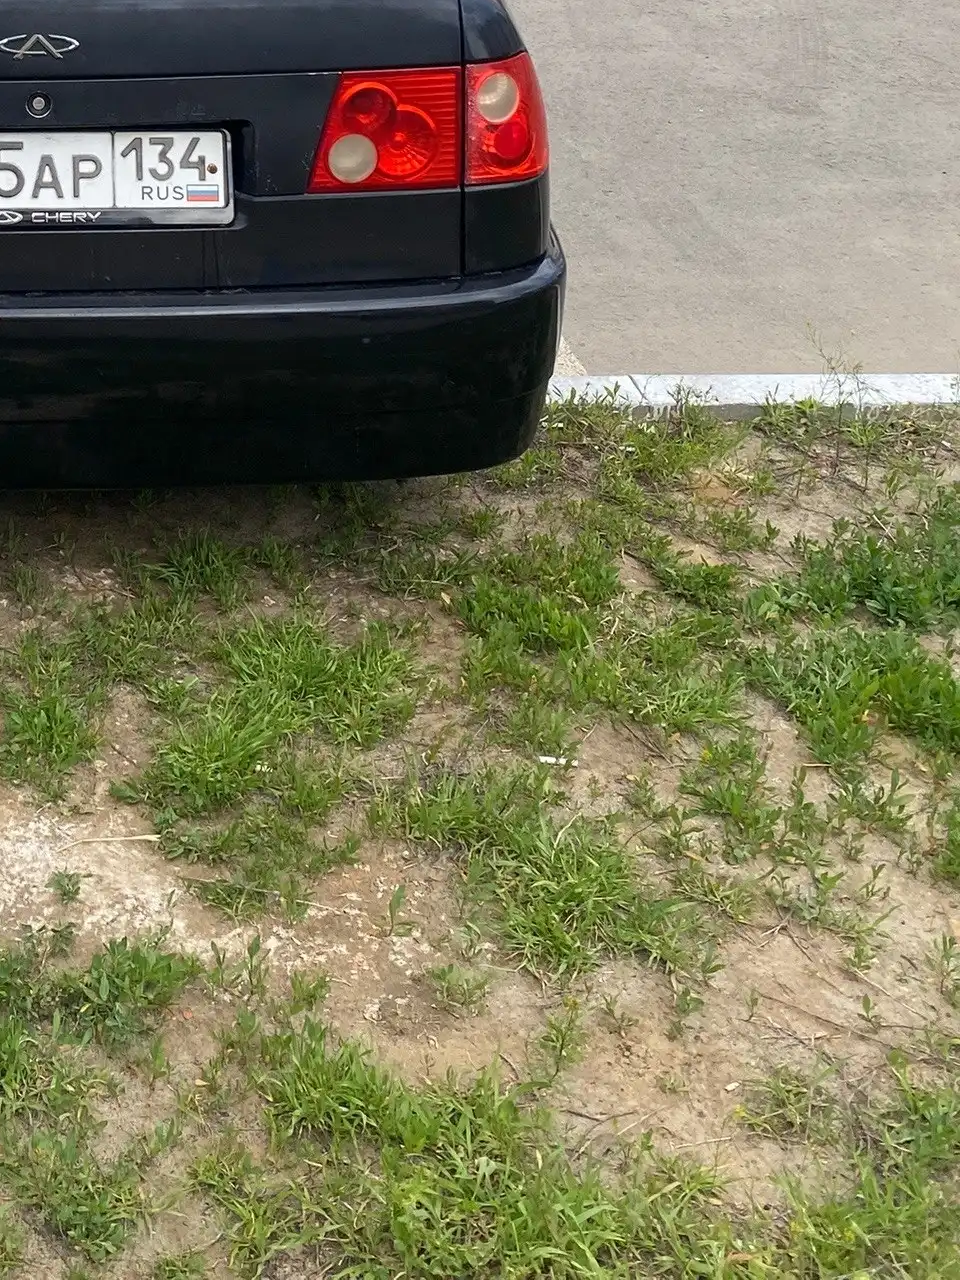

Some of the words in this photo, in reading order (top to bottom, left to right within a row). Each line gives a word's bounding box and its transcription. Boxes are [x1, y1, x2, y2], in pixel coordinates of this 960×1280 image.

[121, 137, 206, 181] 134
[141, 185, 185, 201] RUS
[31, 211, 103, 223] CHERY
